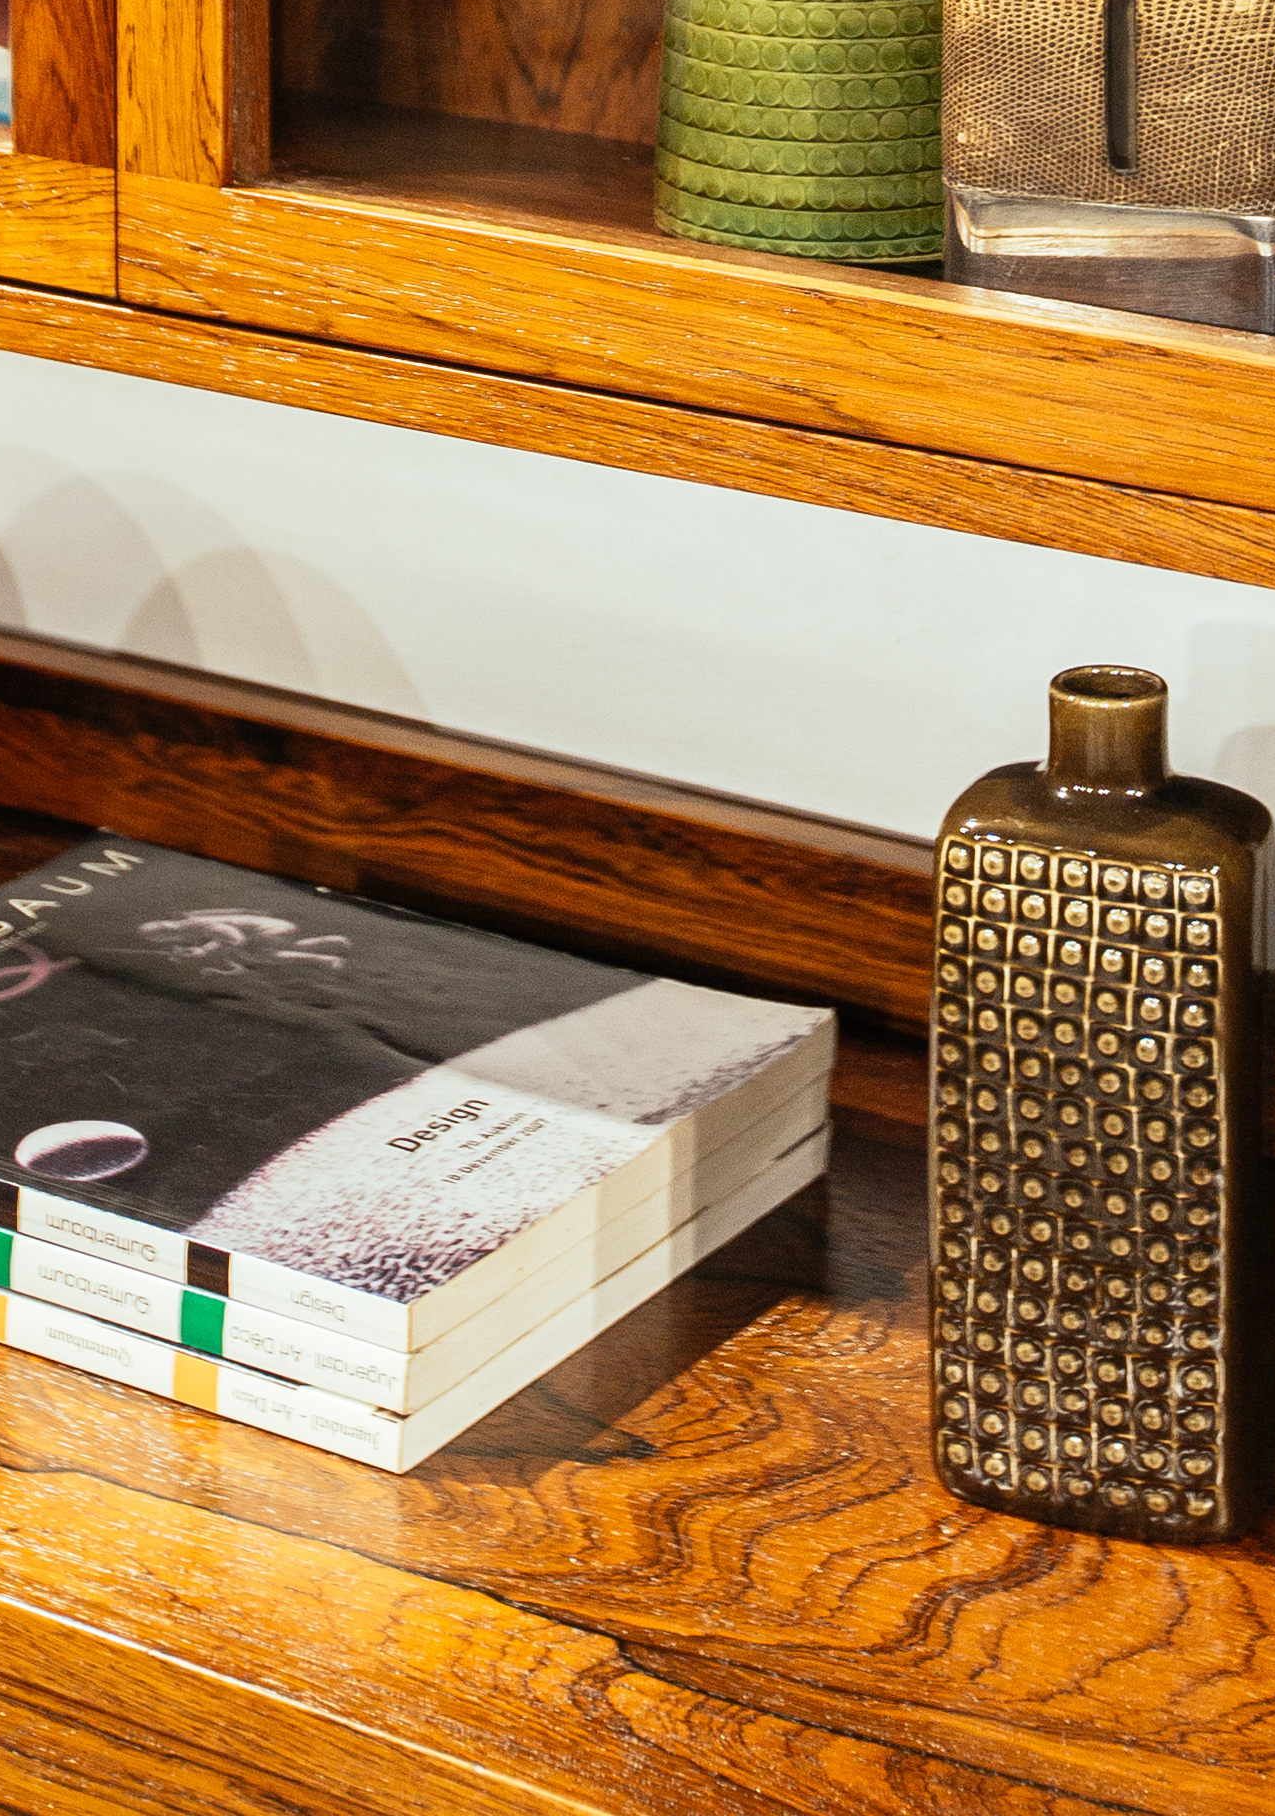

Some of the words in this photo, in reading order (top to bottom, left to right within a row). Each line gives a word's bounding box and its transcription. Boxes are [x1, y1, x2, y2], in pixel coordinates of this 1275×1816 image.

[387, 1098, 492, 1154] Design
[44, 1212, 160, 1264] Quittenbaum
[37, 1264, 152, 1316] Quittenbaum
[290, 1288, 347, 1323] Design
[45, 1326, 134, 1369] Quittenbaum
[313, 1352, 399, 1392] Jugendstil
[310, 1412, 382, 1451] Jugendstil
